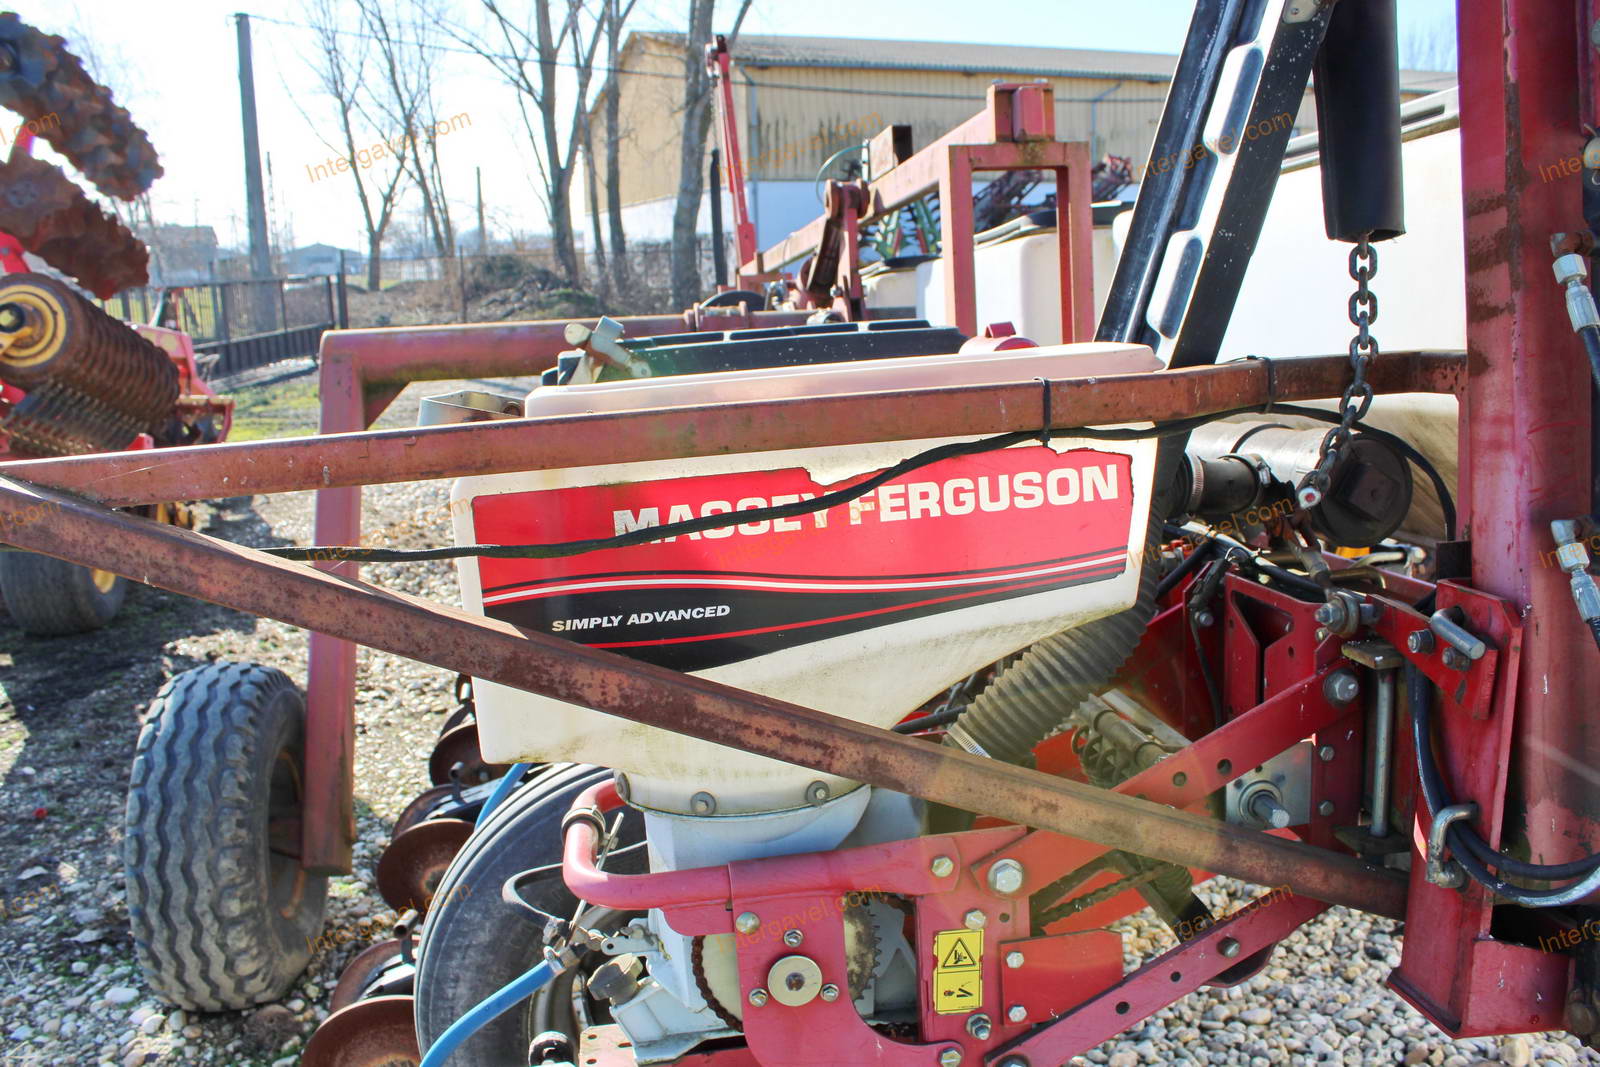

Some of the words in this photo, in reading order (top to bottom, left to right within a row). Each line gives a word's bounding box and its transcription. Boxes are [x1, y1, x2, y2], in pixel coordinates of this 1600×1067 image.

[849, 463, 1119, 526] FERGUSON
[552, 615, 623, 632] SIMPLY
[626, 604, 731, 626] ADVANCED
